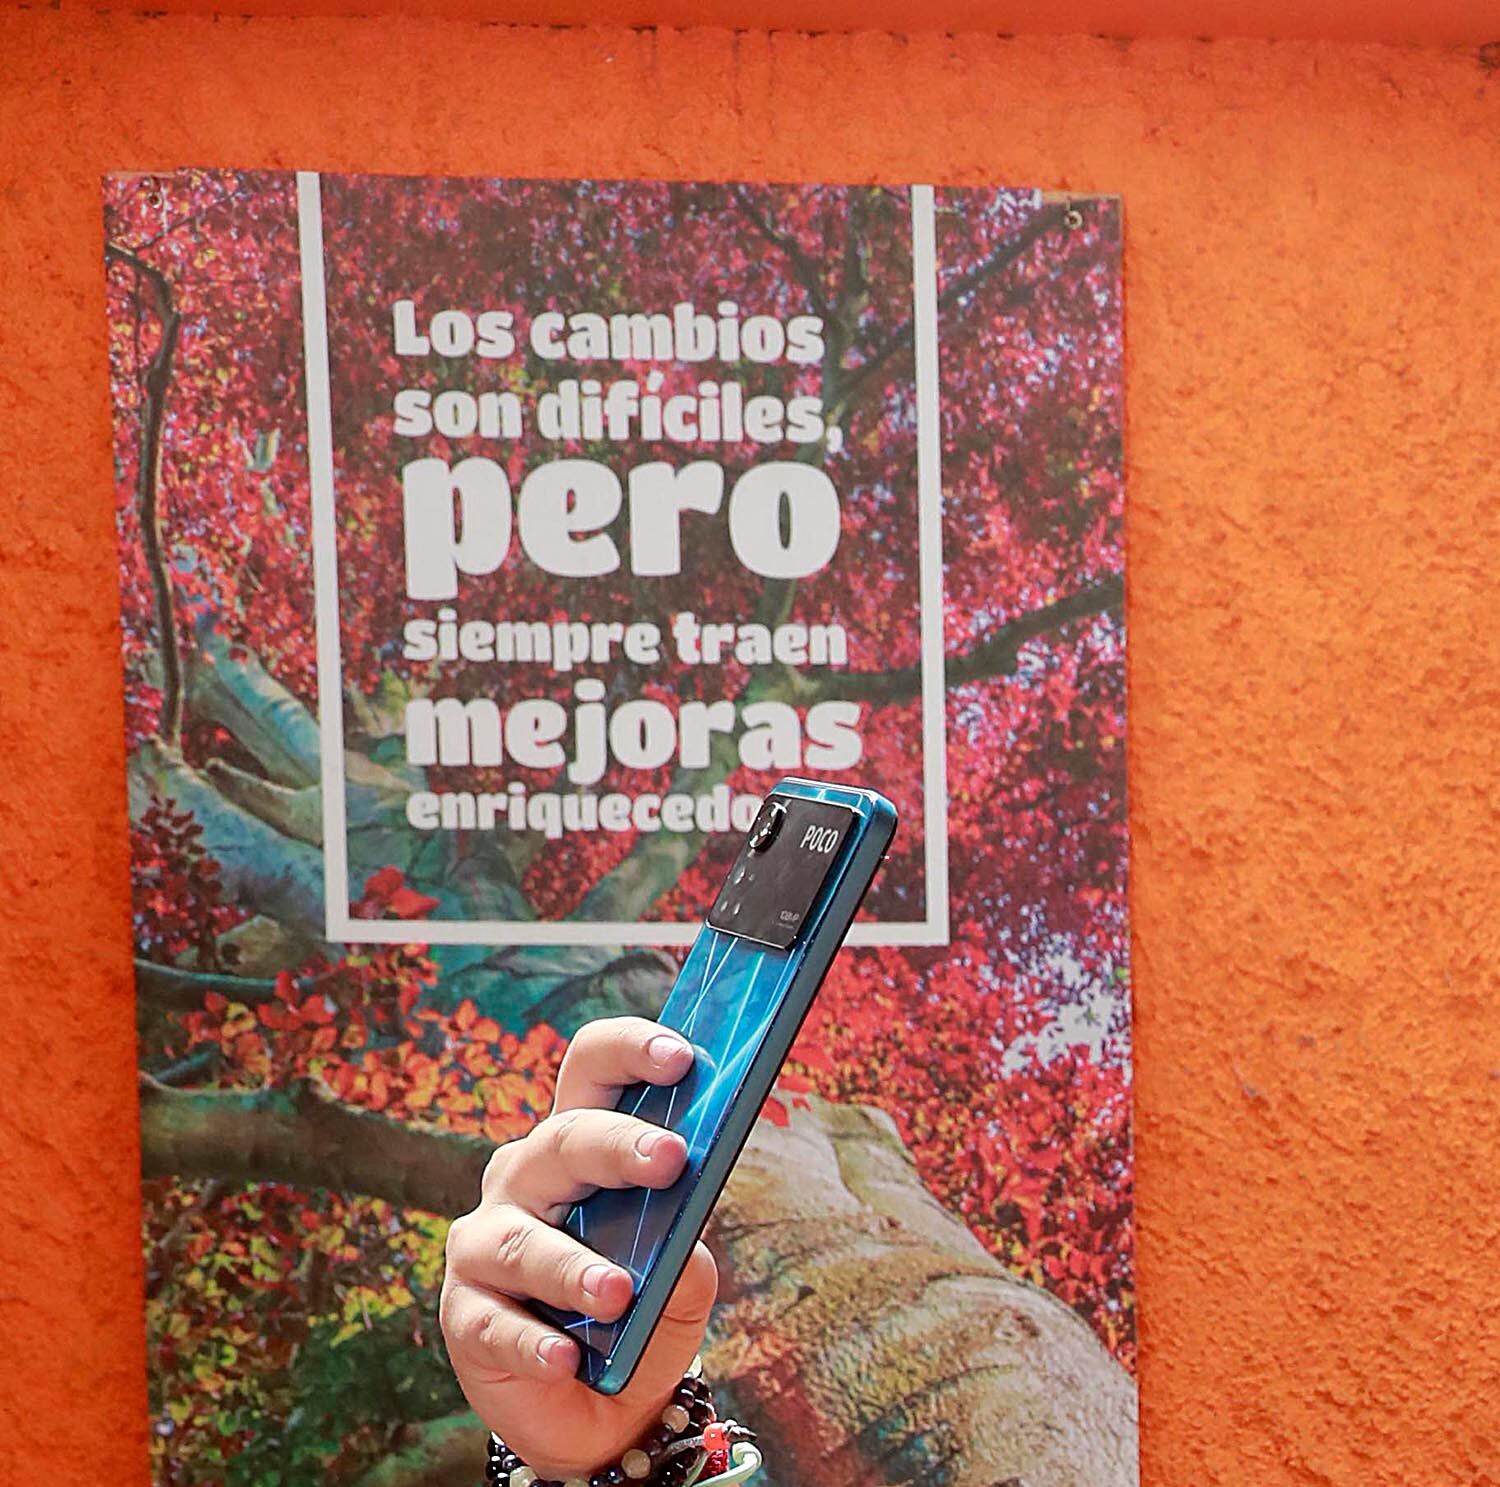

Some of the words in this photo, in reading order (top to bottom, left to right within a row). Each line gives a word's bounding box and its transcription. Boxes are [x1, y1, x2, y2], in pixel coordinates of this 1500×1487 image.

[393, 301, 514, 360] Los
[530, 302, 825, 364] cambios
[393, 389, 524, 438] son
[538, 372, 843, 453] difíciles,
[402, 456, 841, 600] pero
[403, 608, 660, 672] siempre
[675, 611, 847, 666] traen
[404, 679, 863, 785] mejoras
[405, 783, 763, 838] enriquecedo
[800, 825, 839, 853] POCO
